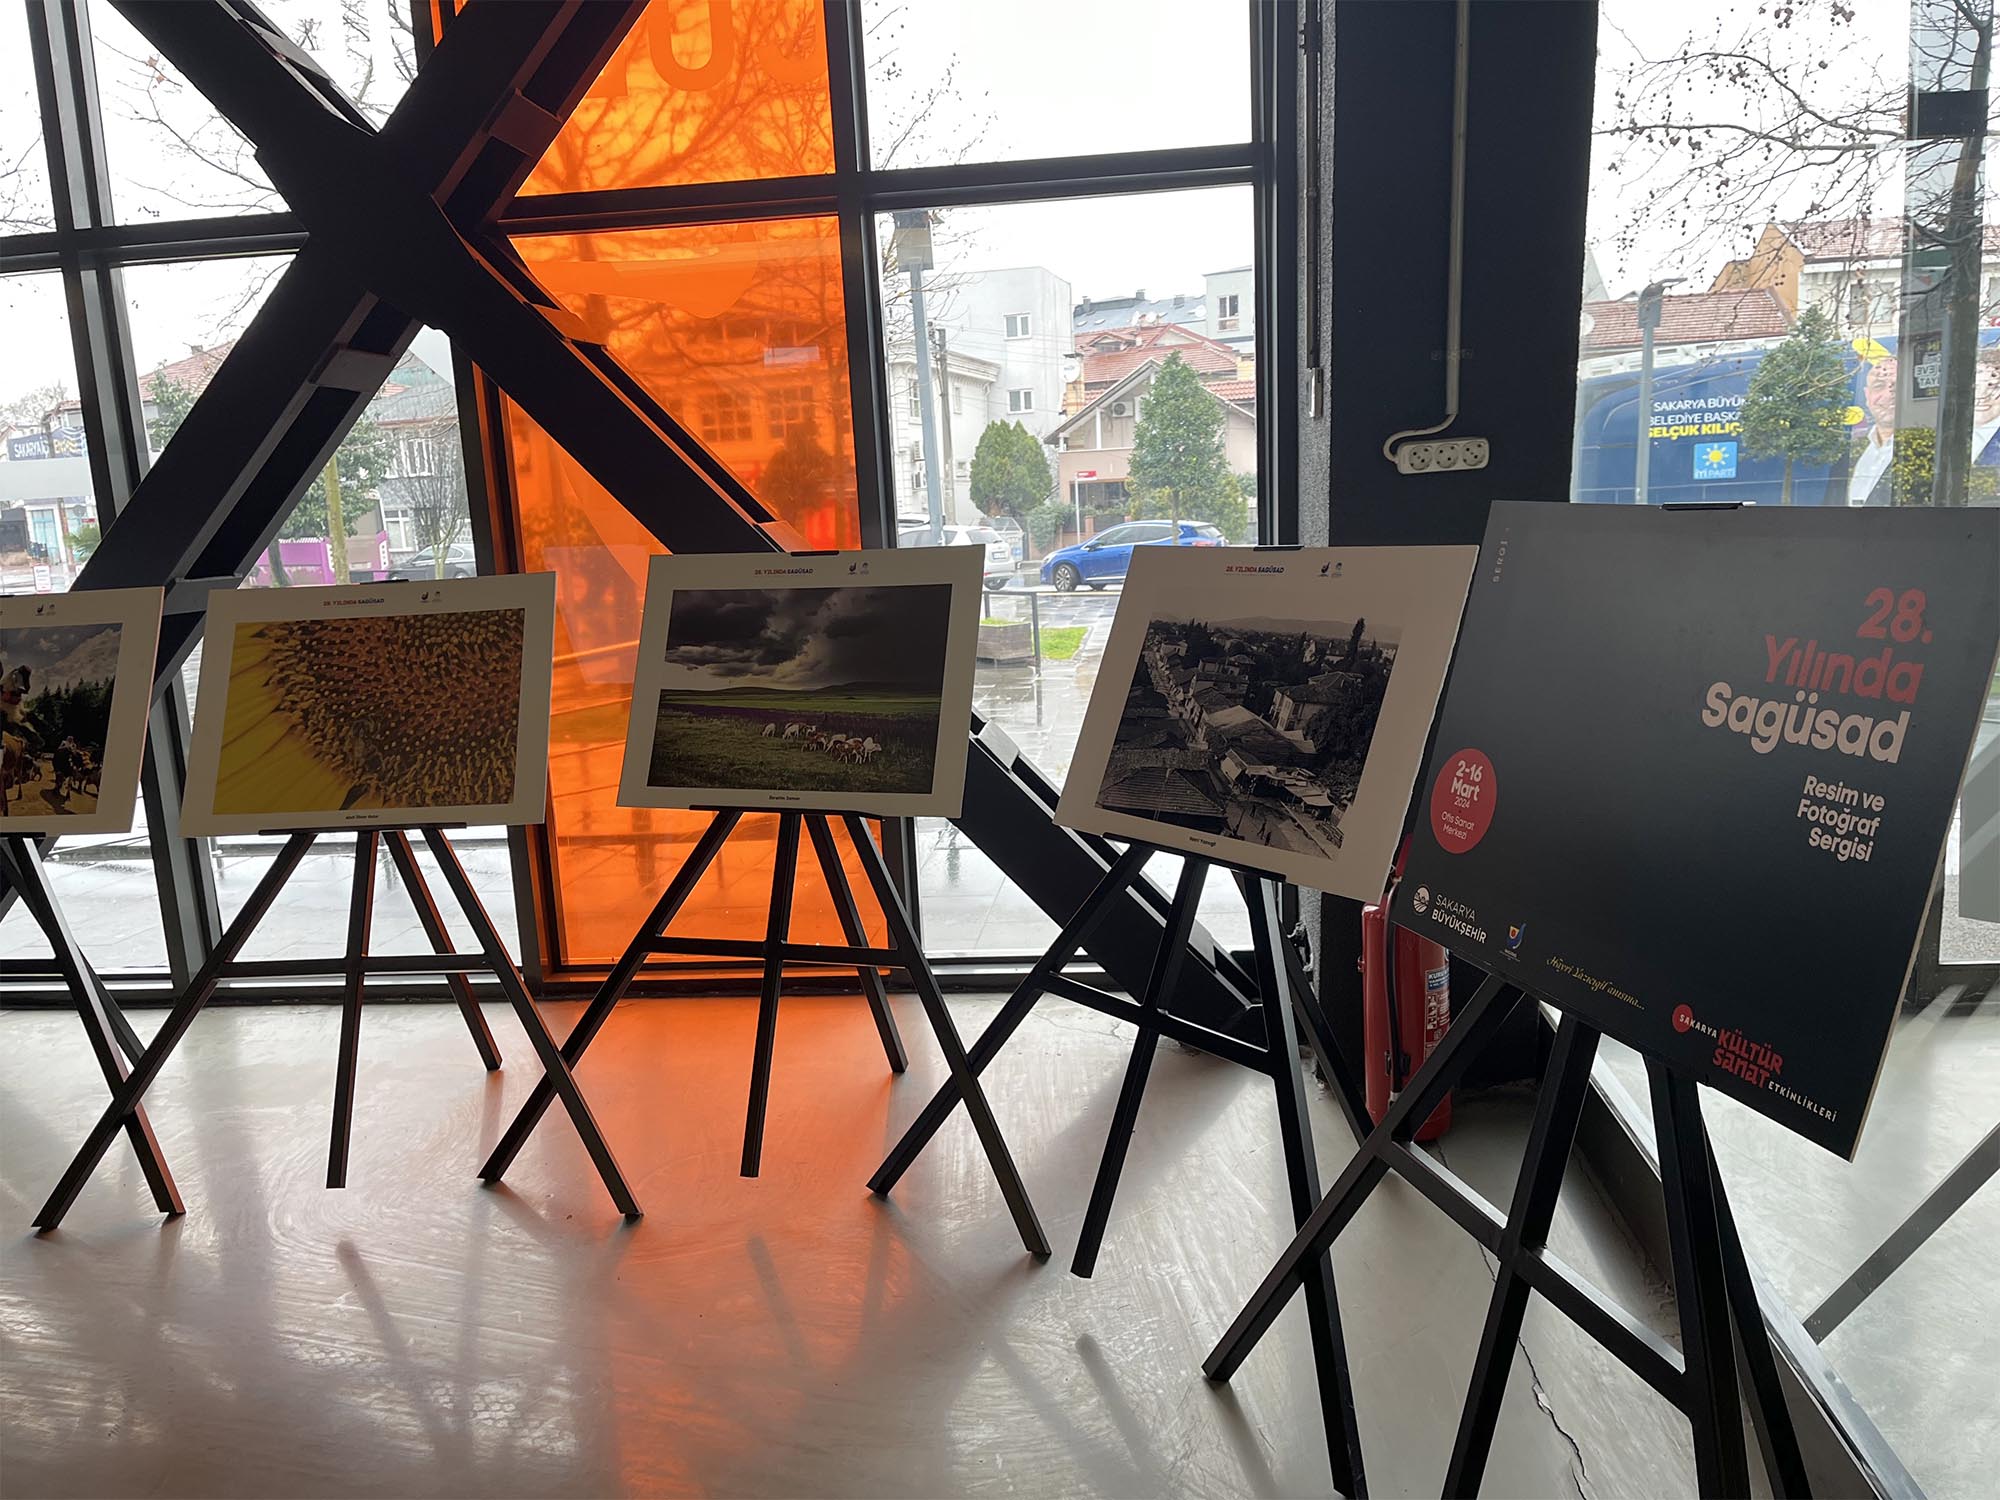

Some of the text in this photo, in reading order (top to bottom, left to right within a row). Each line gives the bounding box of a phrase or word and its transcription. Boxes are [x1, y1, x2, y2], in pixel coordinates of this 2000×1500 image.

[1653, 400, 1706, 412] SAKARYA
[1856, 587, 1933, 644] 28.
[1764, 633, 1925, 705] Yılında
[1702, 681, 1912, 764] Sagüsad
[1455, 760, 1483, 782] 2-16
[1450, 777, 1480, 801] Mart
[1453, 796, 1471, 809] 2024
[1803, 775, 1885, 812] Resim ve
[1441, 811, 1475, 831] Ofis Sanat
[1442, 824, 1467, 840] Merkezi
[1797, 798, 1881, 837] Fotoğraf
[1808, 827, 1874, 862] Sergisi
[1435, 894, 1476, 922] SAKARYA
[1431, 908, 1487, 944] BÜYÜKŞEHİR
[1679, 1014, 1718, 1038] SAKARYA
[1717, 1029, 1784, 1075] KÜLTÜR
[1768, 1080, 1839, 1123] ETKİNLİKLERİ
